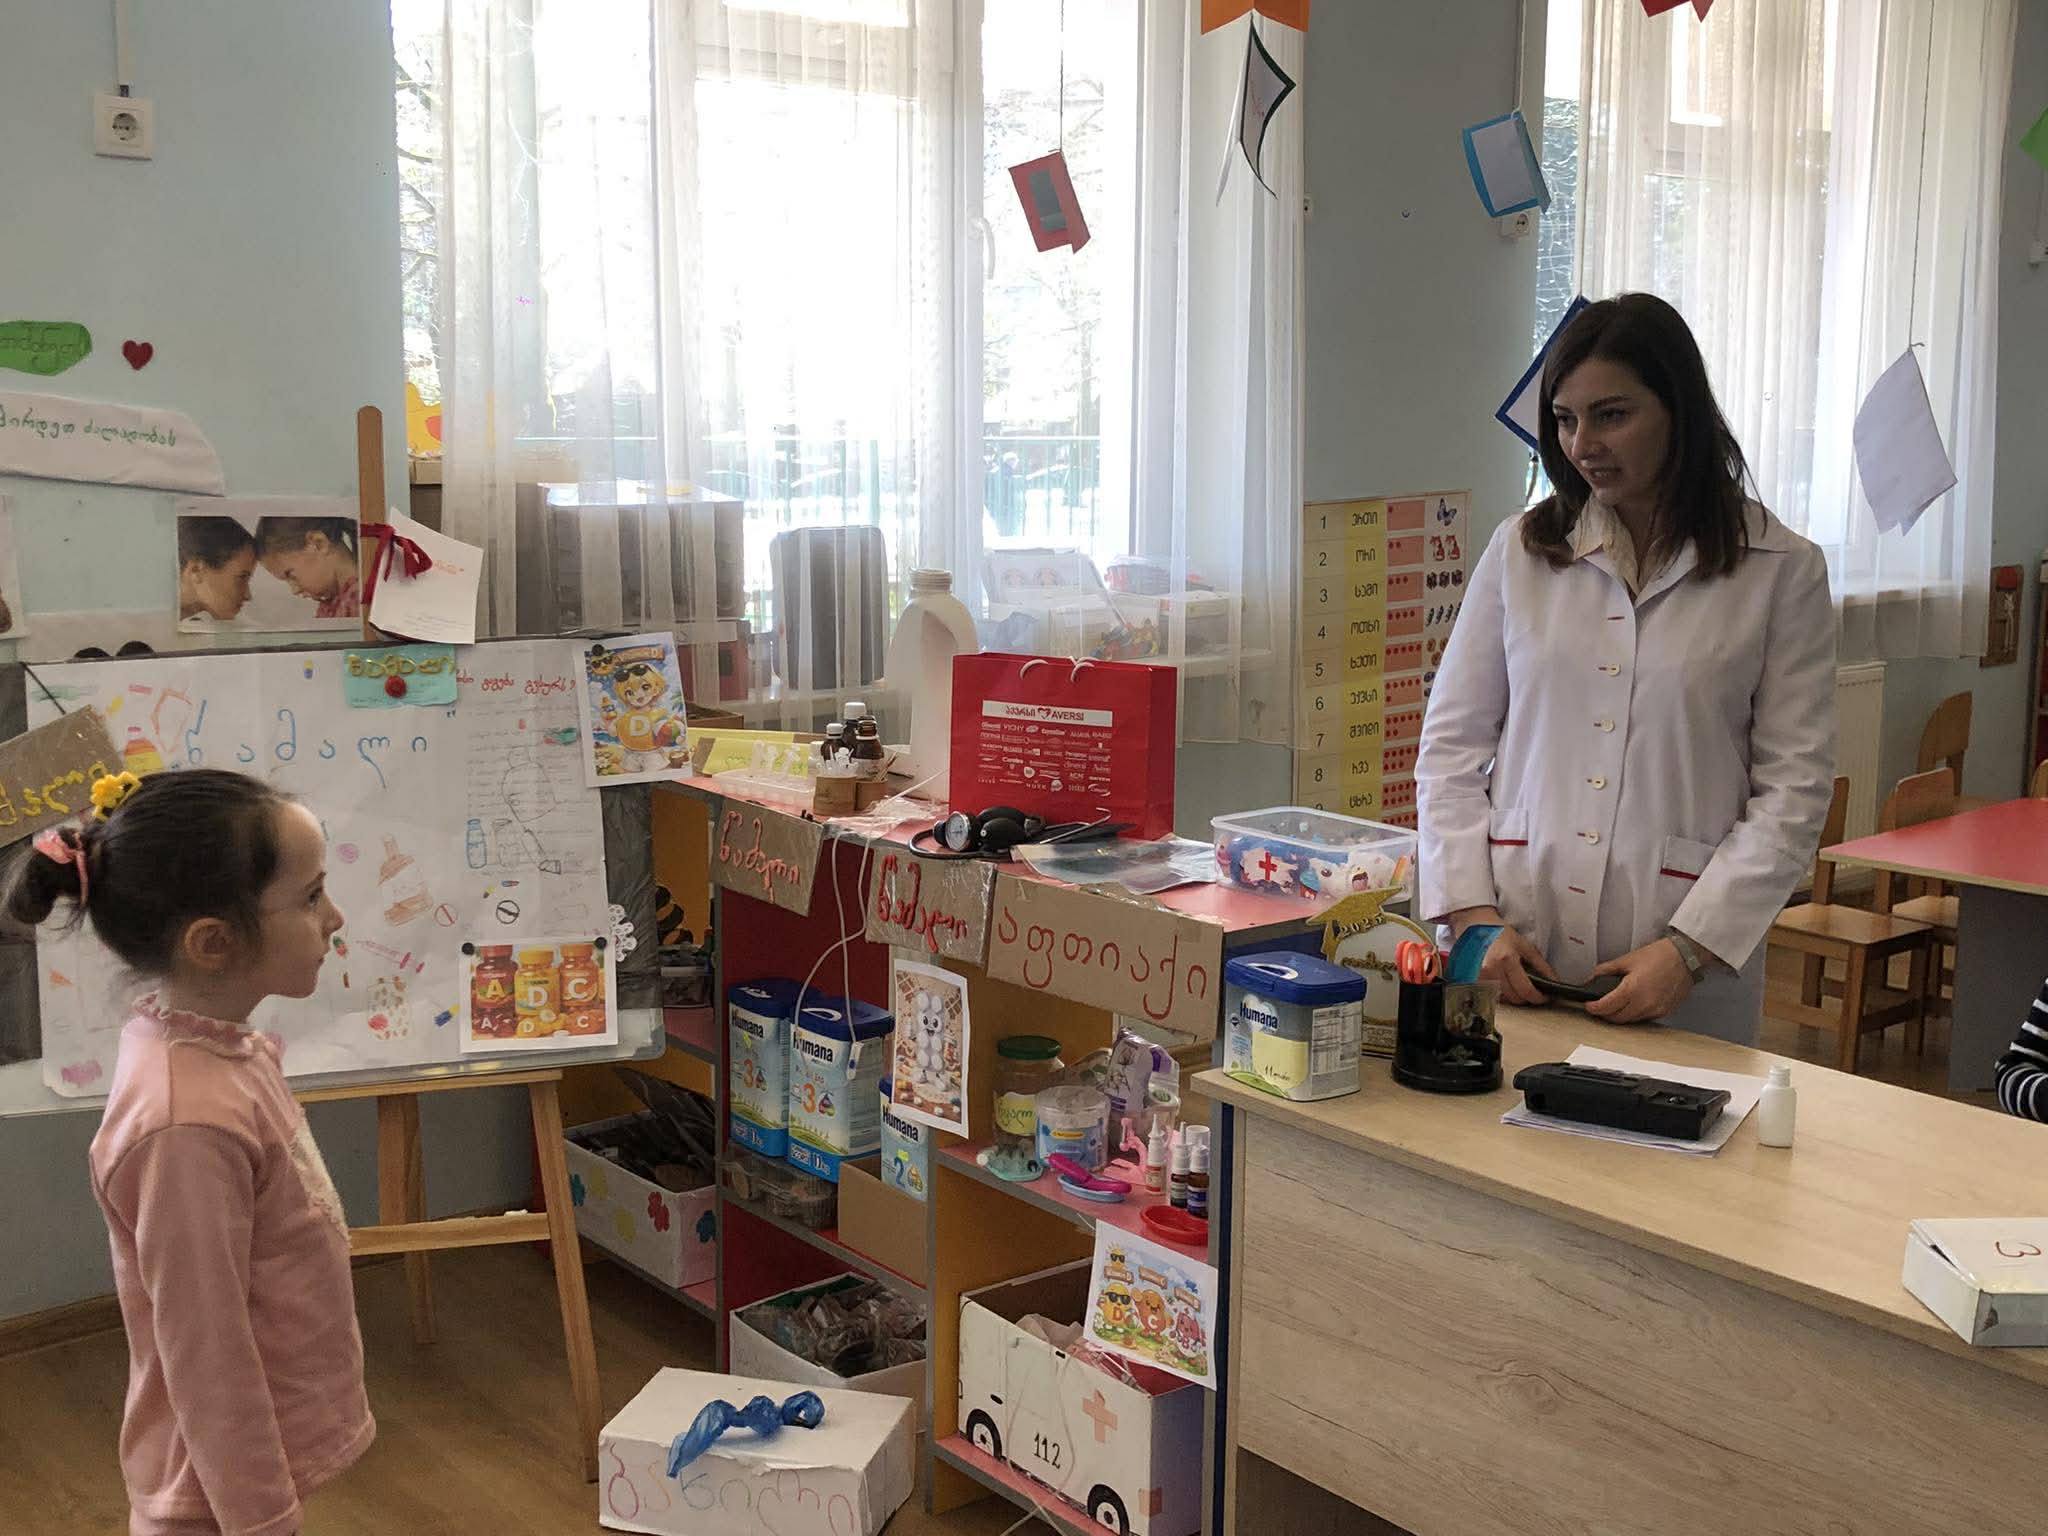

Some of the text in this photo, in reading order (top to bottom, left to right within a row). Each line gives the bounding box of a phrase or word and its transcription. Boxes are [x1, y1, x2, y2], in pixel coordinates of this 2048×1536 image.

[1320, 516, 1327, 530] 1
[1319, 552, 1328, 567] 2
[1319, 588, 1328, 602] 3
[1317, 625, 1327, 639] 4
[1315, 663, 1324, 677] 5
[1315, 696, 1324, 711] 6
[1052, 711, 1085, 721] AVERSI
[629, 716, 651, 737] D
[1315, 733, 1325, 747] 7
[1314, 767, 1323, 782] 8
[719, 810, 801, 904] წამალი
[877, 855, 969, 954] წამალი
[998, 906, 1207, 1020] აფთიაქი
[486, 978, 588, 1008] A D C
[731, 1006, 764, 1039] Humana
[1239, 1001, 1278, 1029] Humana
[480, 1016, 589, 1032] A D C
[802, 1083, 817, 1114] 3
[882, 1104, 919, 1142] Humana
[1147, 1313, 1159, 1329] C
[1033, 1431, 1061, 1470] 112
